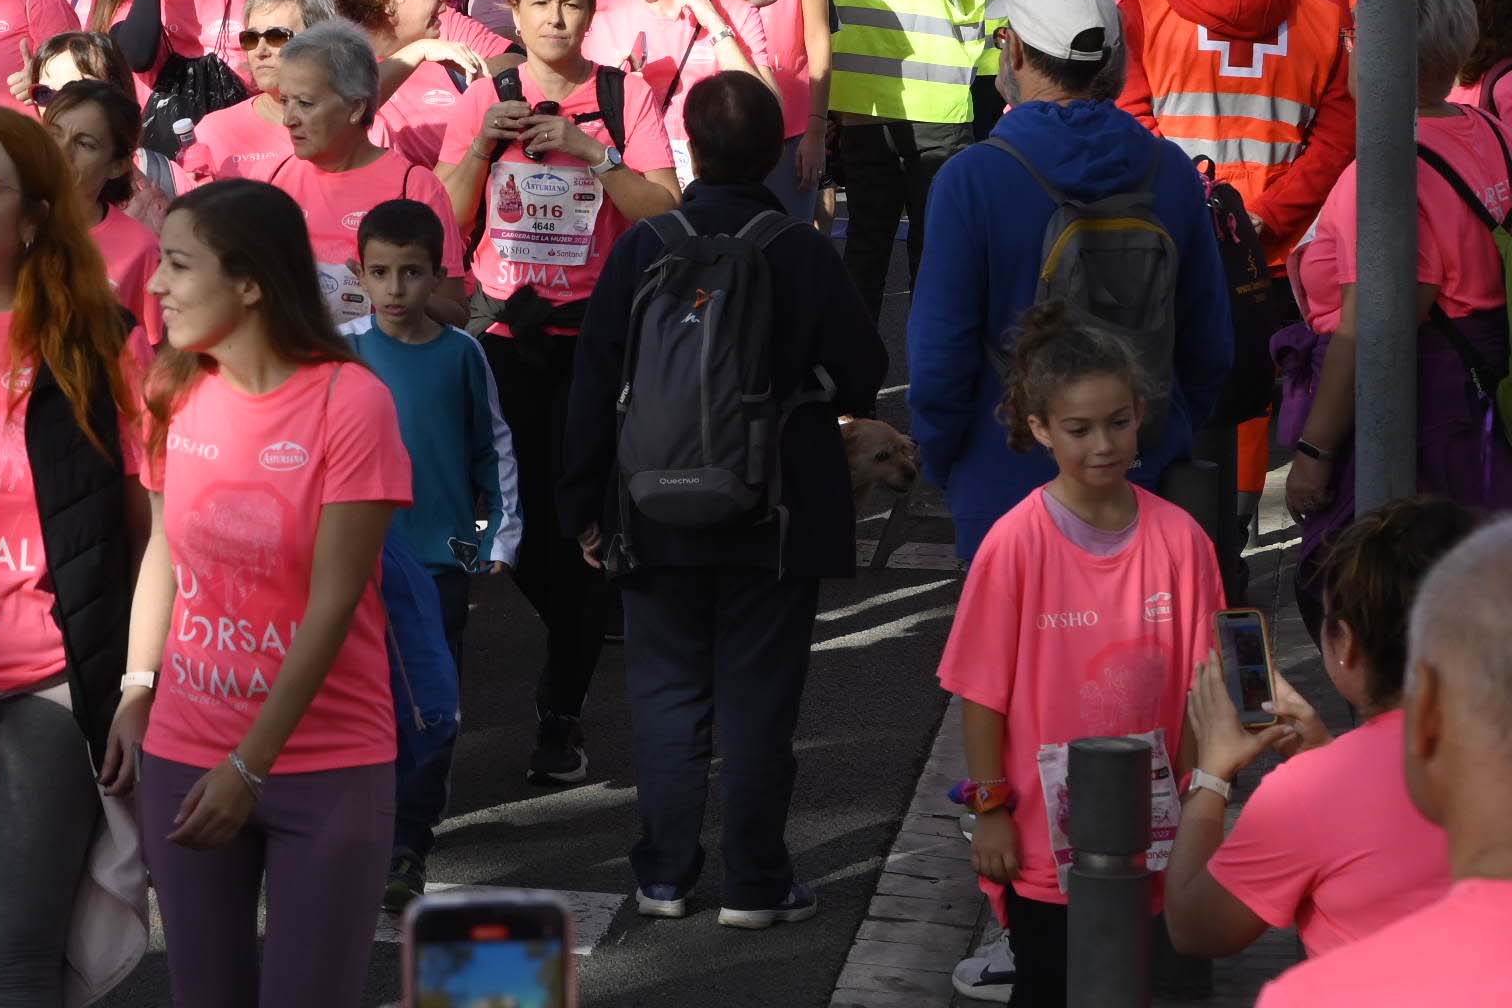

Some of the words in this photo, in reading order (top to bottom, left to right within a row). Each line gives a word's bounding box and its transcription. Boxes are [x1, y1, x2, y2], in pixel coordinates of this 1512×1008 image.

[522, 180, 569, 194] ASTURIANA
[525, 202, 565, 219] 016
[530, 221, 557, 233] 4648
[497, 260, 570, 288] SUMA
[1037, 610, 1098, 630] OYSHO
[171, 652, 270, 699] SUMA
